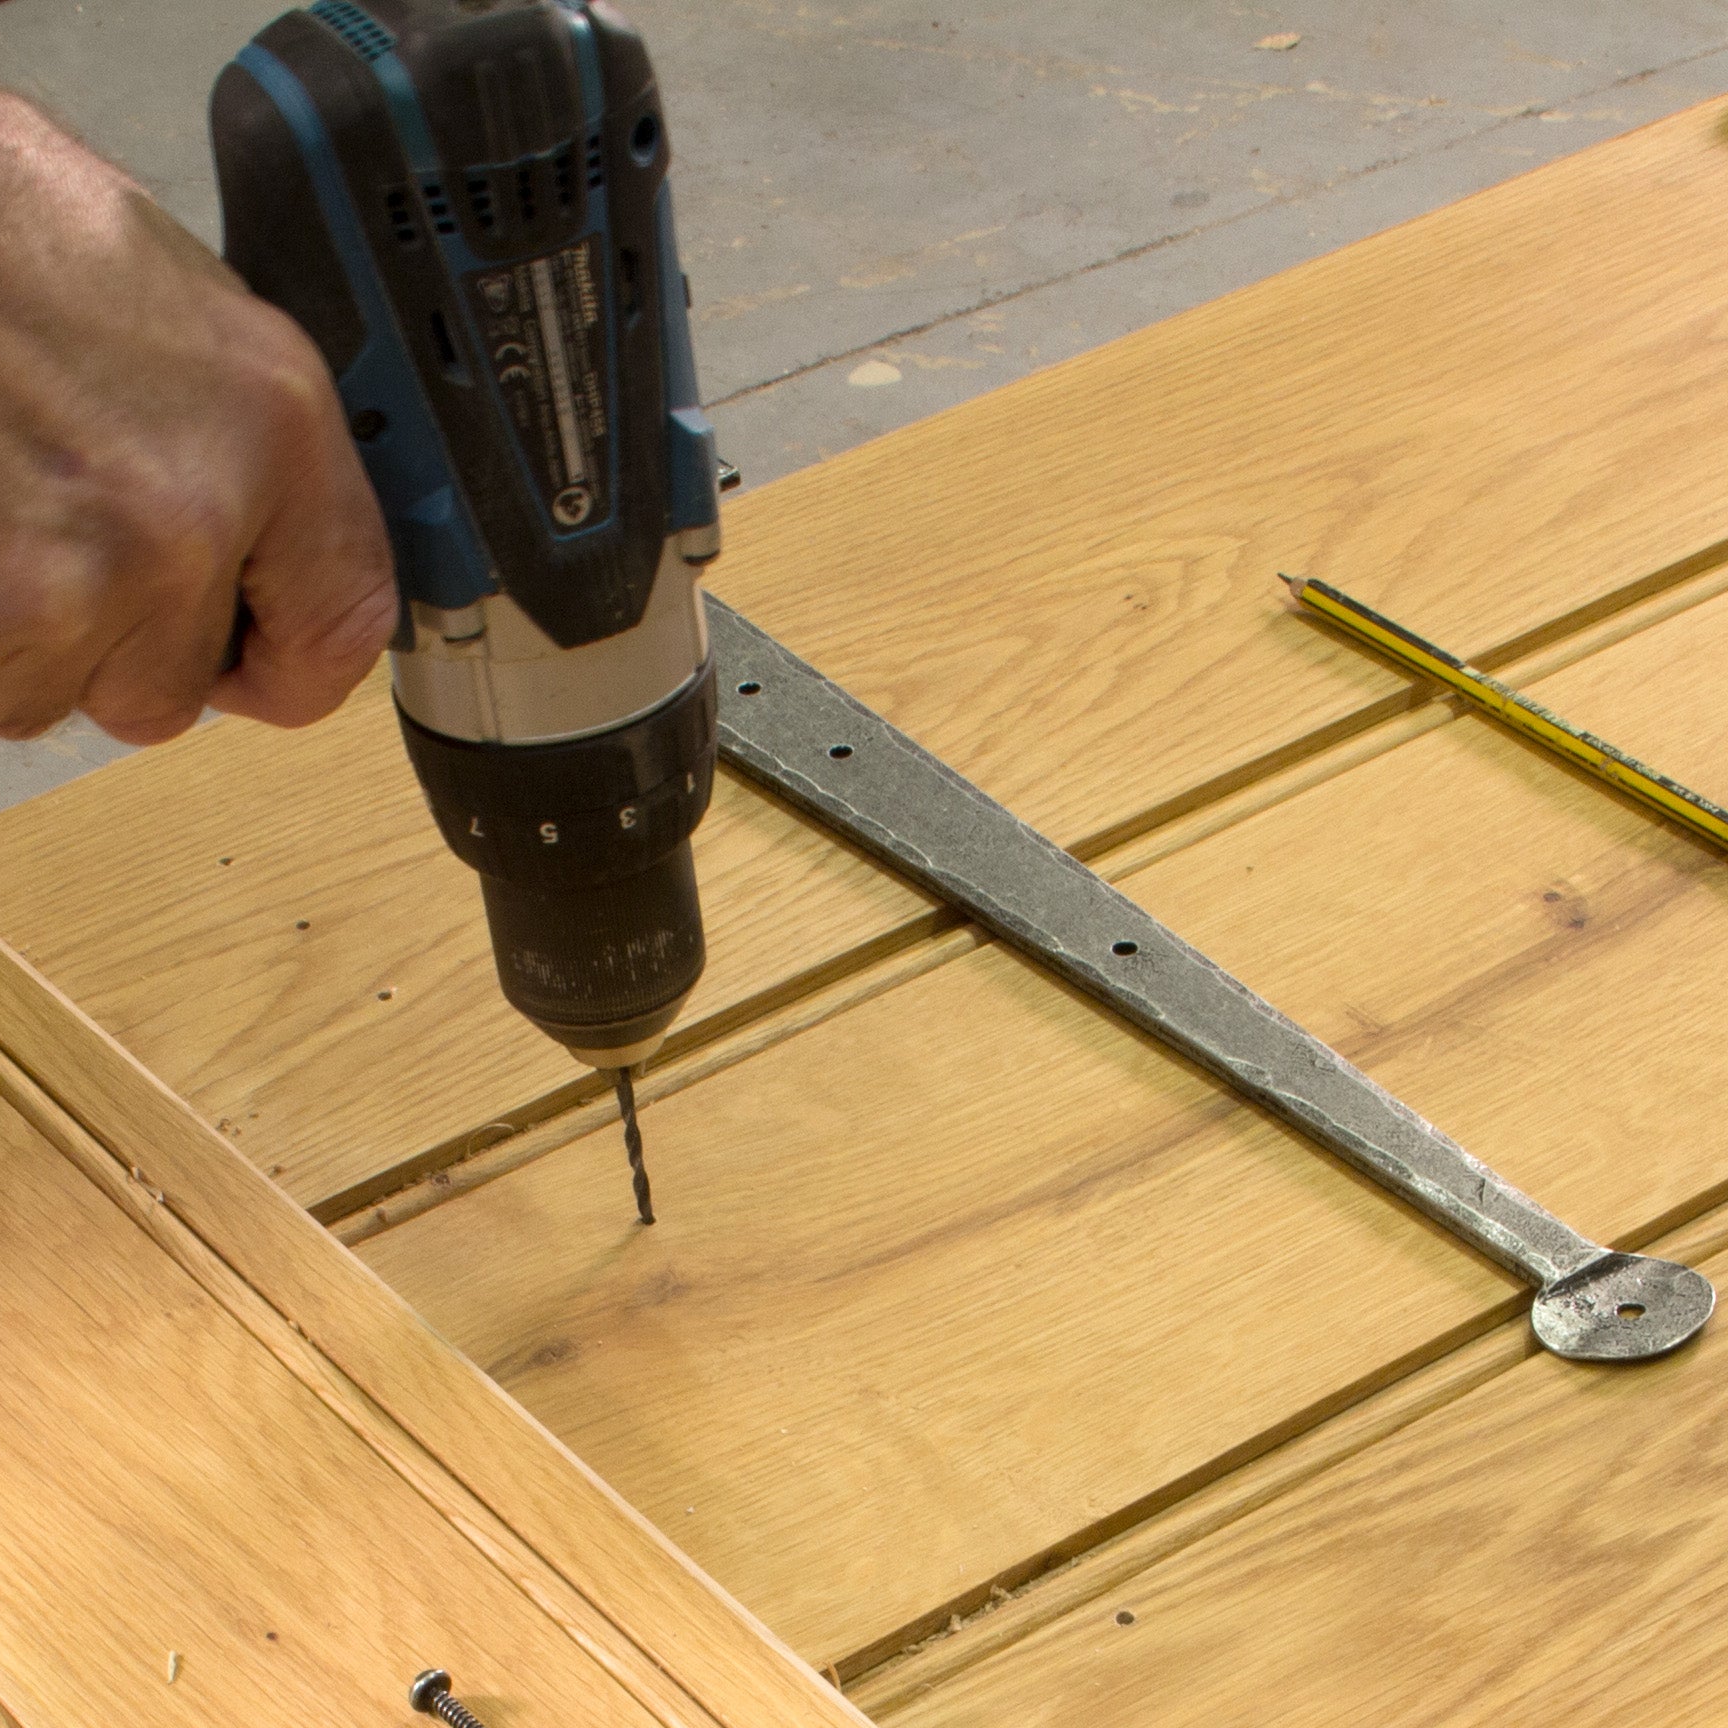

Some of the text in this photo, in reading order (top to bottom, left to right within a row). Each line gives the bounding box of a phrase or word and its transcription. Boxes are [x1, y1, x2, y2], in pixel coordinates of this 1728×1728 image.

[470, 816, 485, 837] 7
[619, 807, 637, 830] 3
[539, 822, 560, 843] 5
